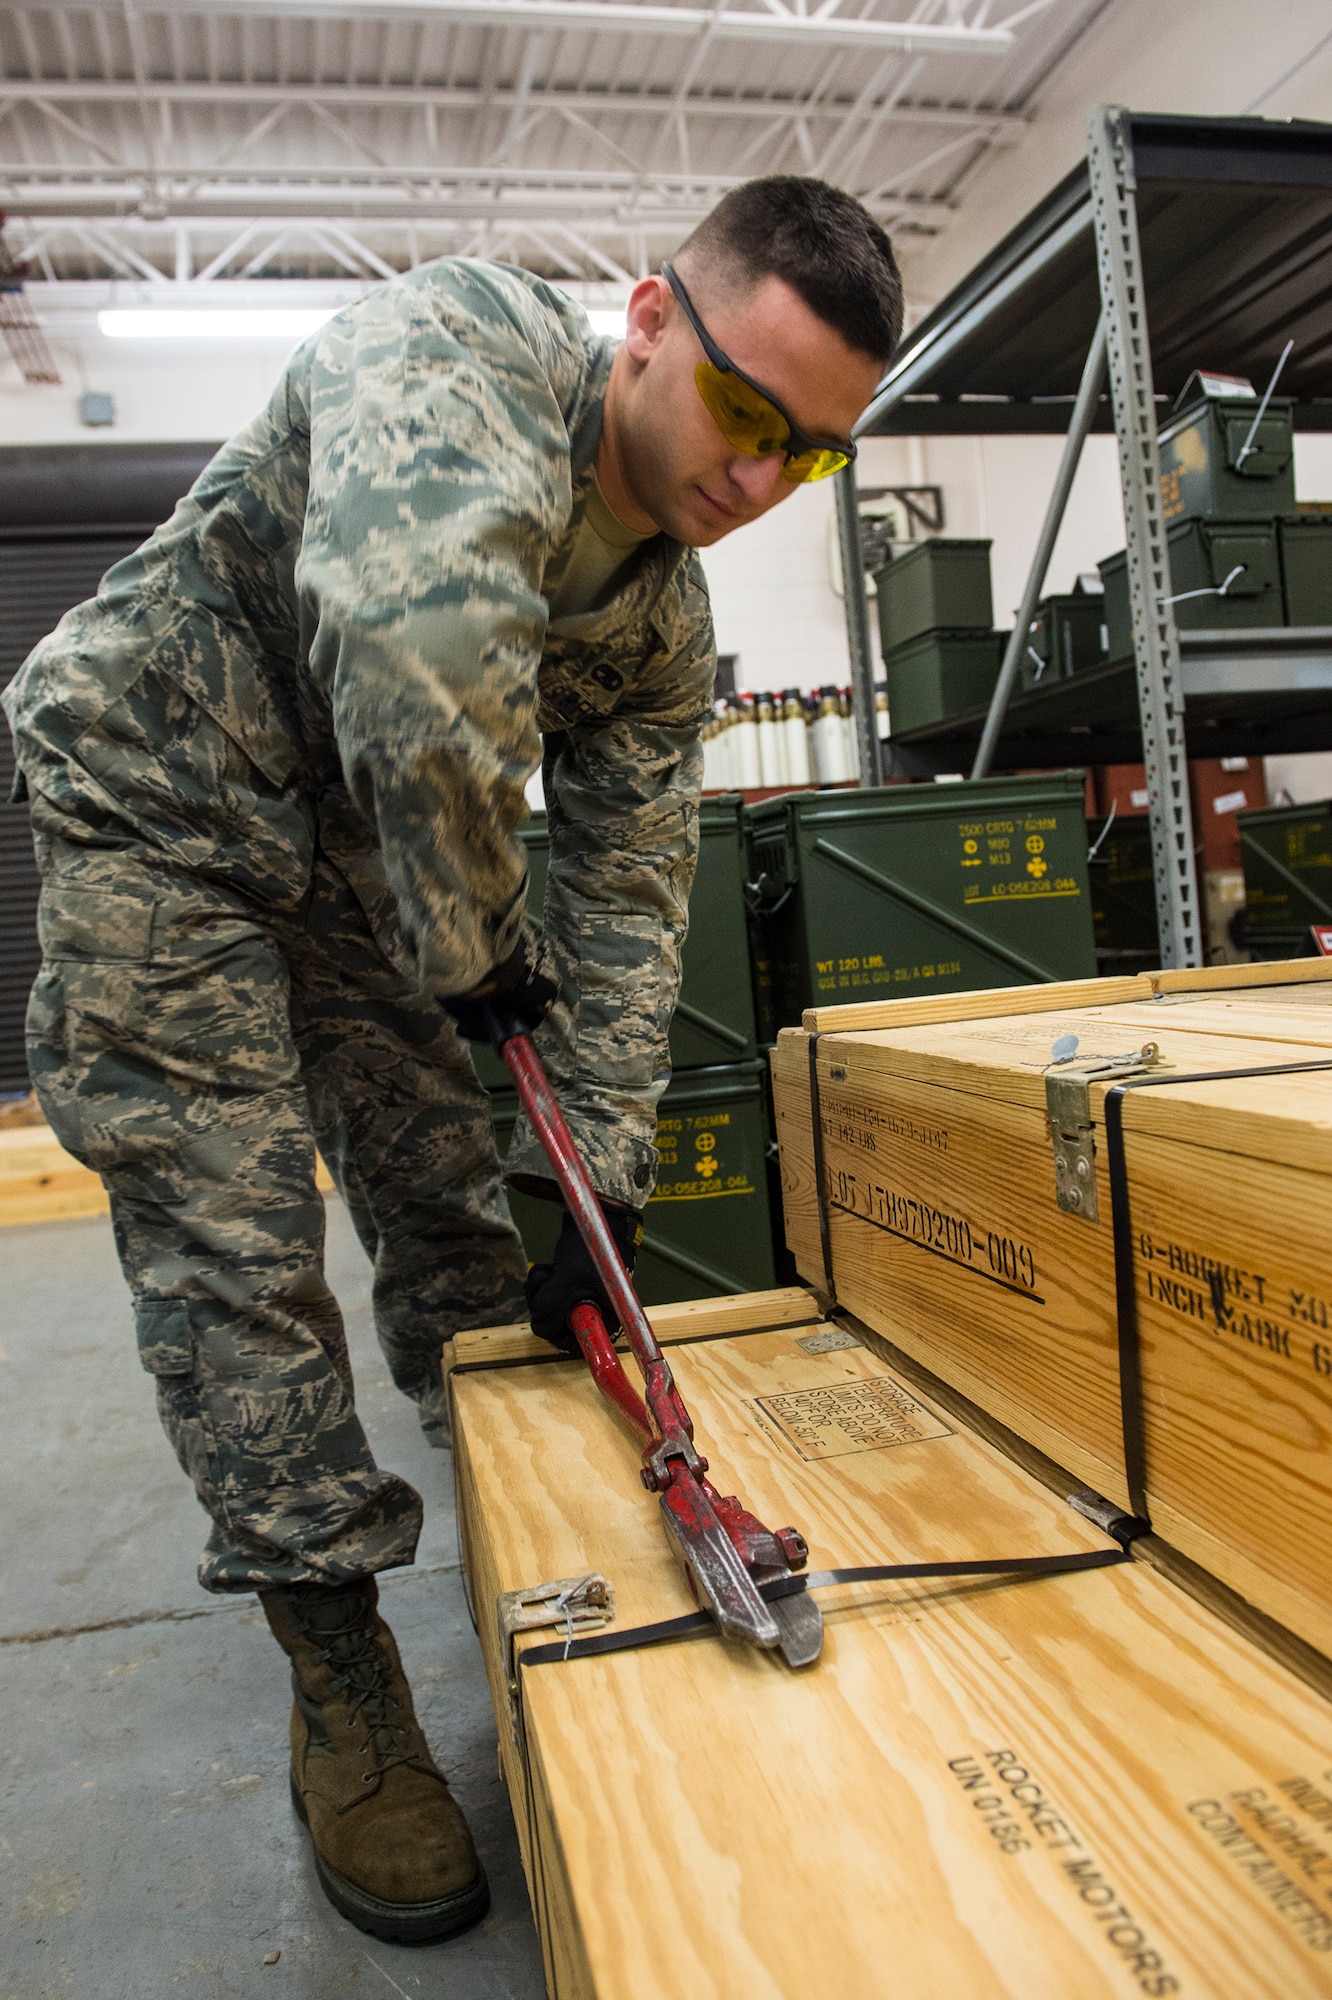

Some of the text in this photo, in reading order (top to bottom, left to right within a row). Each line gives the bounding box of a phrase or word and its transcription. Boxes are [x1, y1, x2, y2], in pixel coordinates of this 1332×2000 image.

[816, 960, 834, 973] WT
[838, 958, 859, 971] 120
[828, 1166, 856, 1210] LOT
[1147, 1270, 1204, 1320] INCH
[767, 1396, 804, 1425] BELOW
[810, 1390, 875, 1445] STORE ABOVE
[850, 1383, 922, 1440] TEMPERATURE
[870, 1379, 922, 1416] STORAGE
[808, 1413, 832, 1428] OR
[855, 1413, 882, 1427] DO
[868, 1424, 904, 1446] NOT
[947, 1755, 1032, 1855] UN 0186
[985, 1749, 1180, 1998] ROCKET MOTORS
[1187, 1799, 1332, 1952] CONTAINERS
